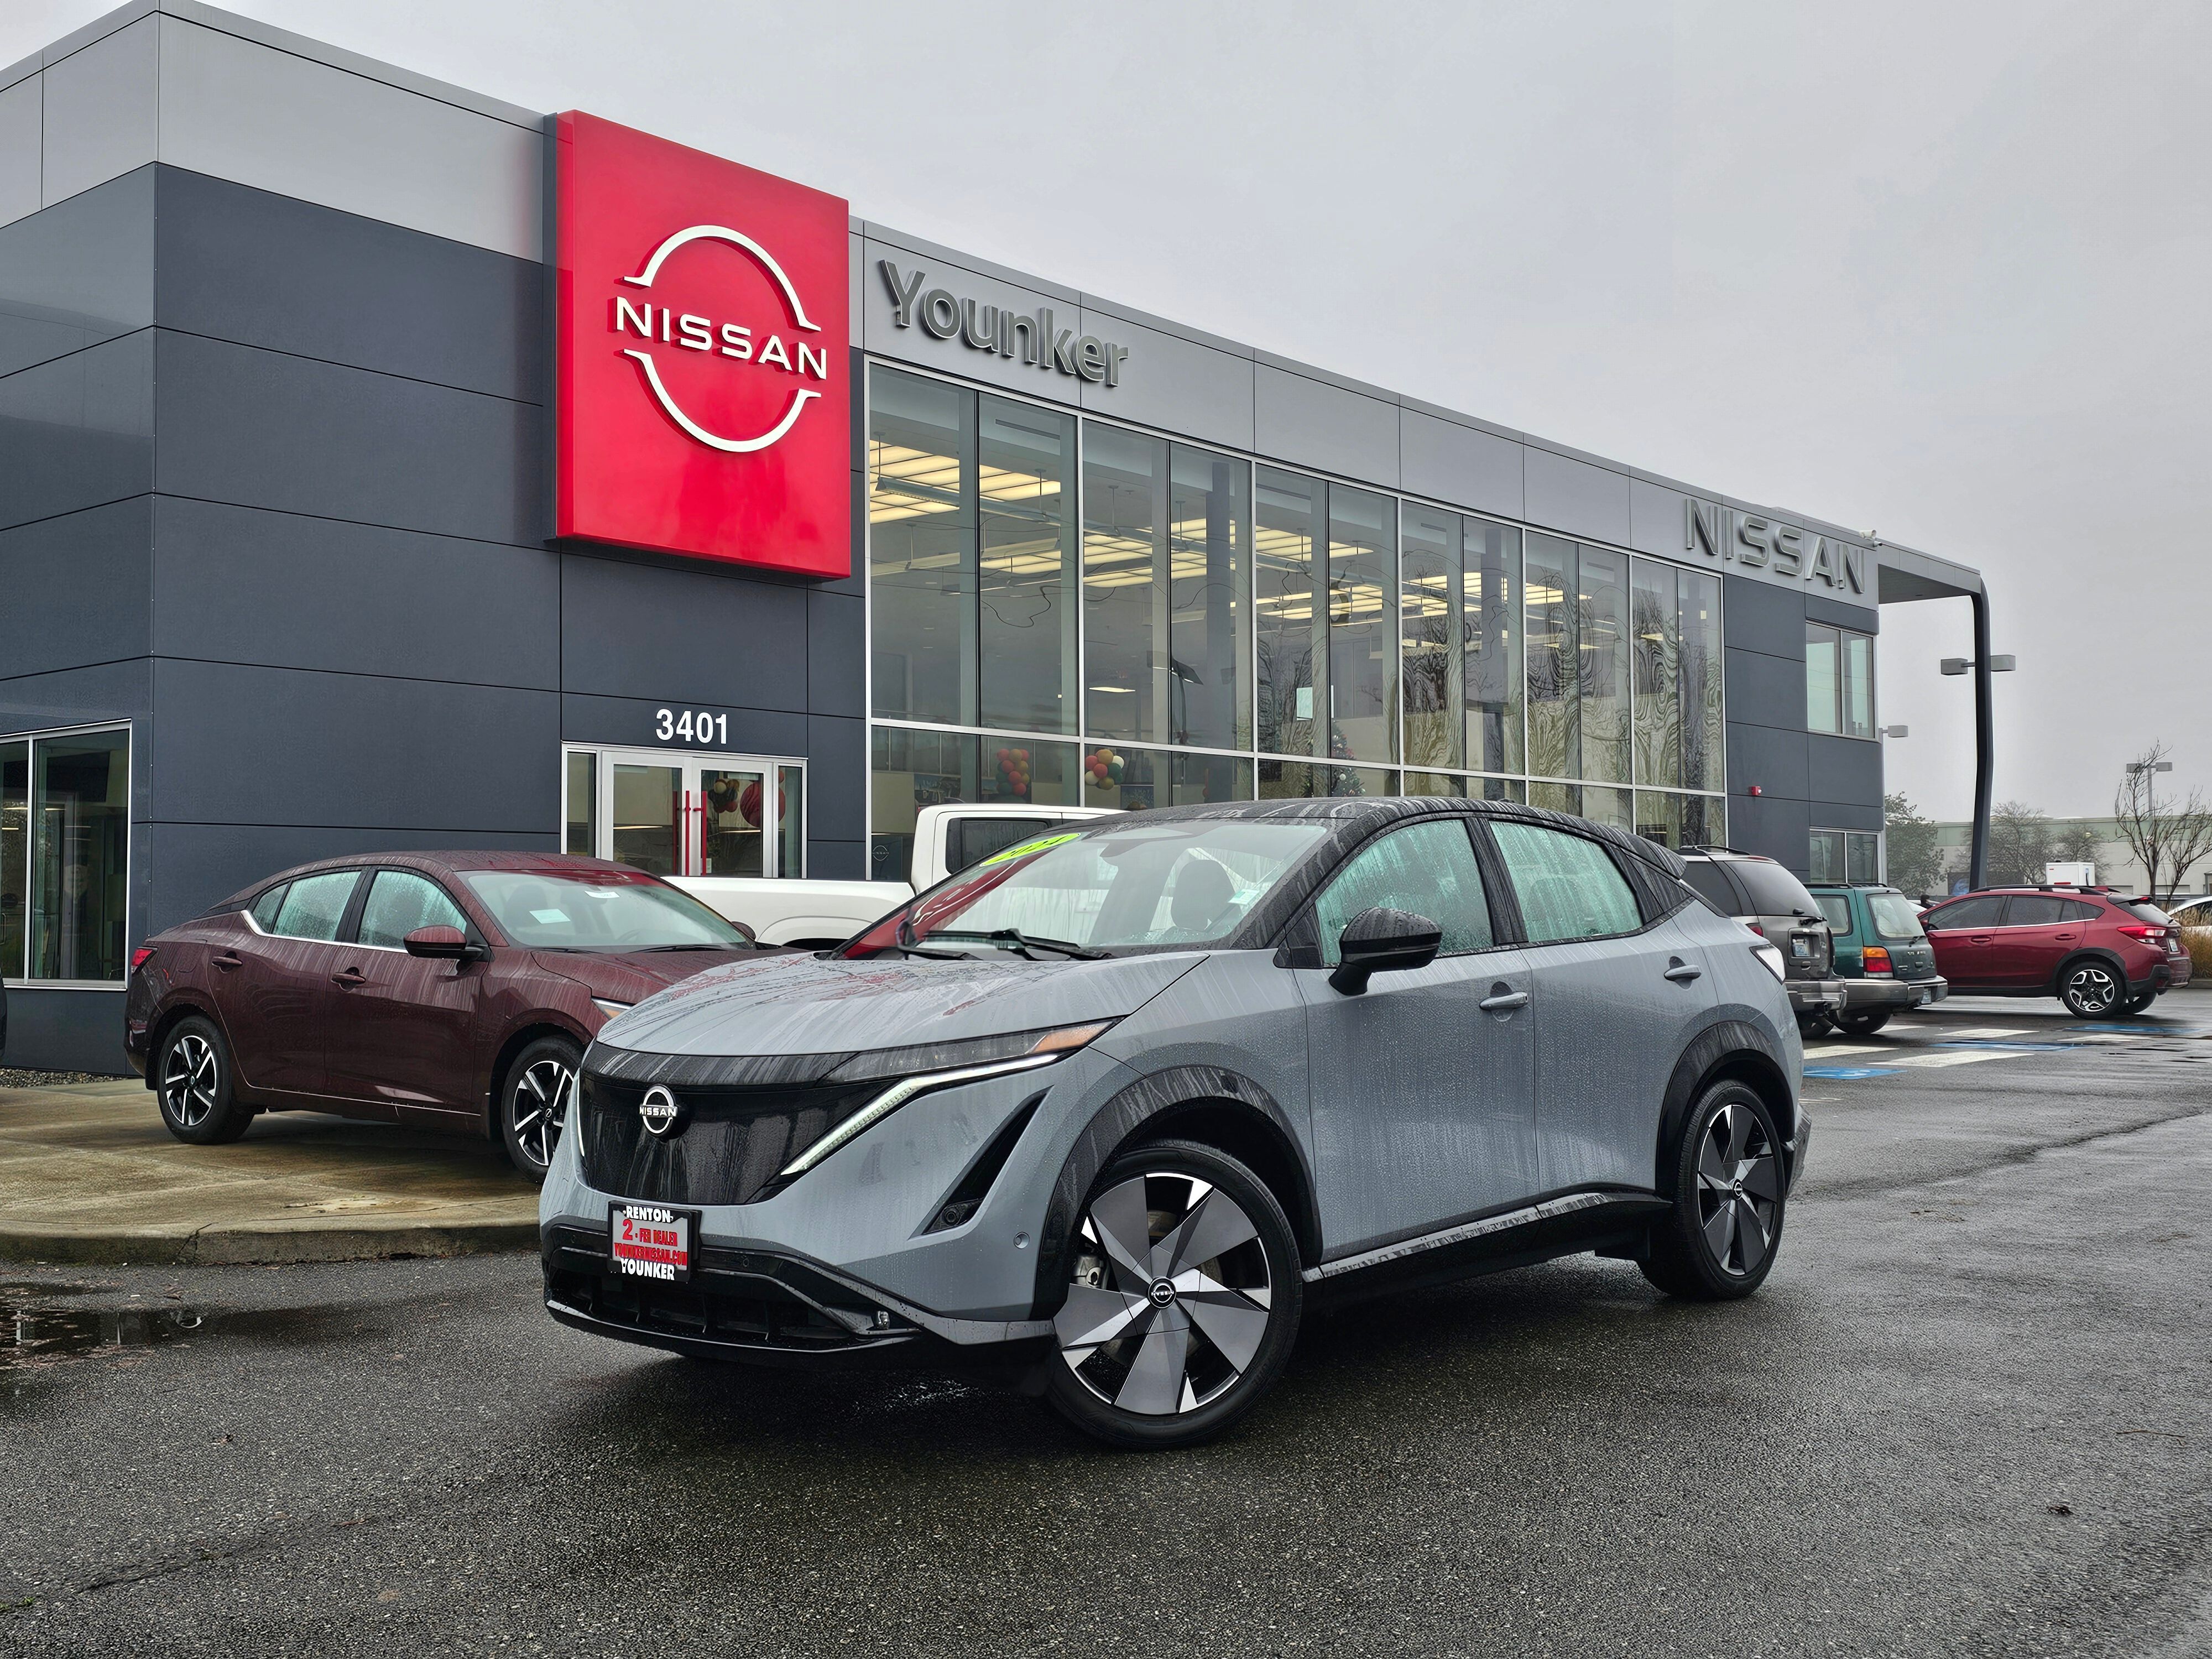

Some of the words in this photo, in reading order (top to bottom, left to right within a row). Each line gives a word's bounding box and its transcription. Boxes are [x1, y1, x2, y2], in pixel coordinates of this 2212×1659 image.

[880, 259, 1129, 387] Younker
[616, 296, 827, 380] NISSAN
[1686, 498, 1865, 594] NISSAN
[656, 708, 727, 744] 3401
[639, 1107, 677, 1117] NISSAN
[625, 1206, 671, 1223] RENTON
[622, 1218, 633, 1241] 2
[620, 1258, 675, 1281] YOUNKER
